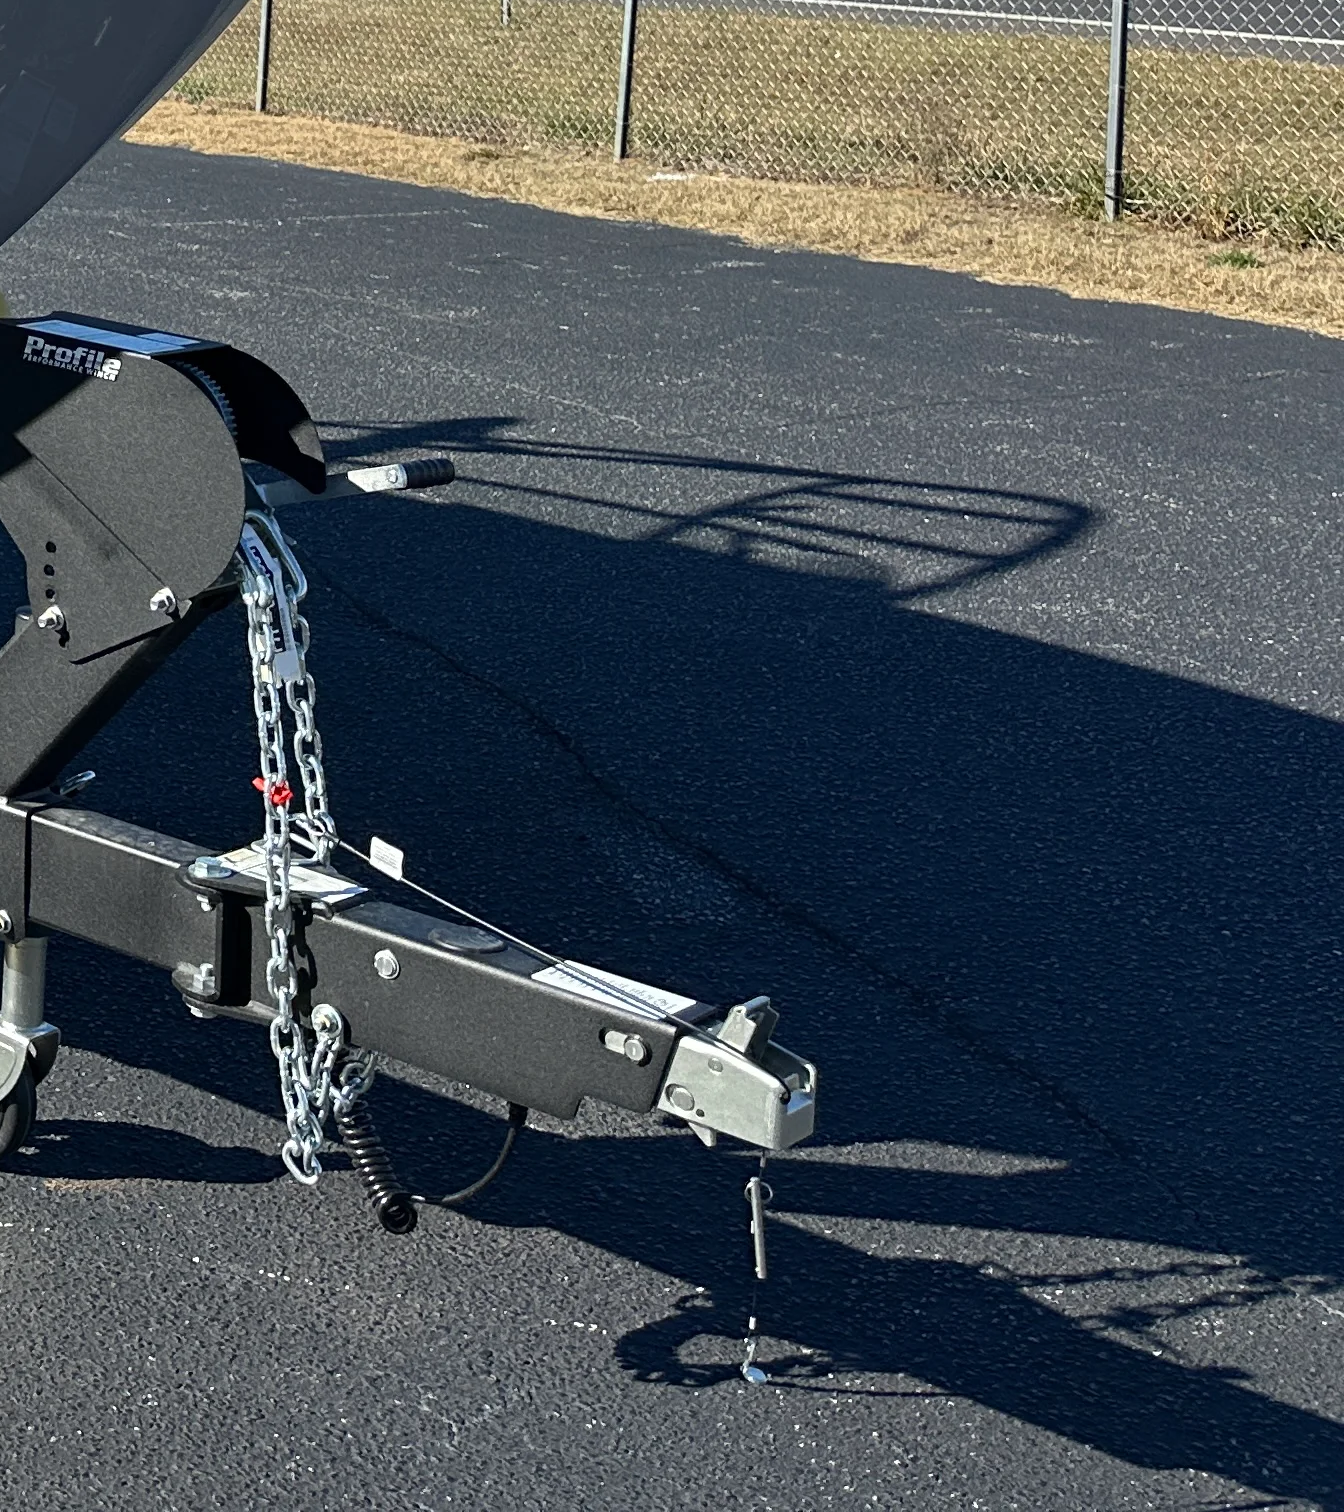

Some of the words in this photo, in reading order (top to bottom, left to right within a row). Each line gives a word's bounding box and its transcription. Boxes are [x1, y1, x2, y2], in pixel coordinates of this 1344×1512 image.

[22, 353, 83, 374] PERFORMANCE
[86, 368, 117, 382] WINCH
[23, 335, 122, 375] Profile
